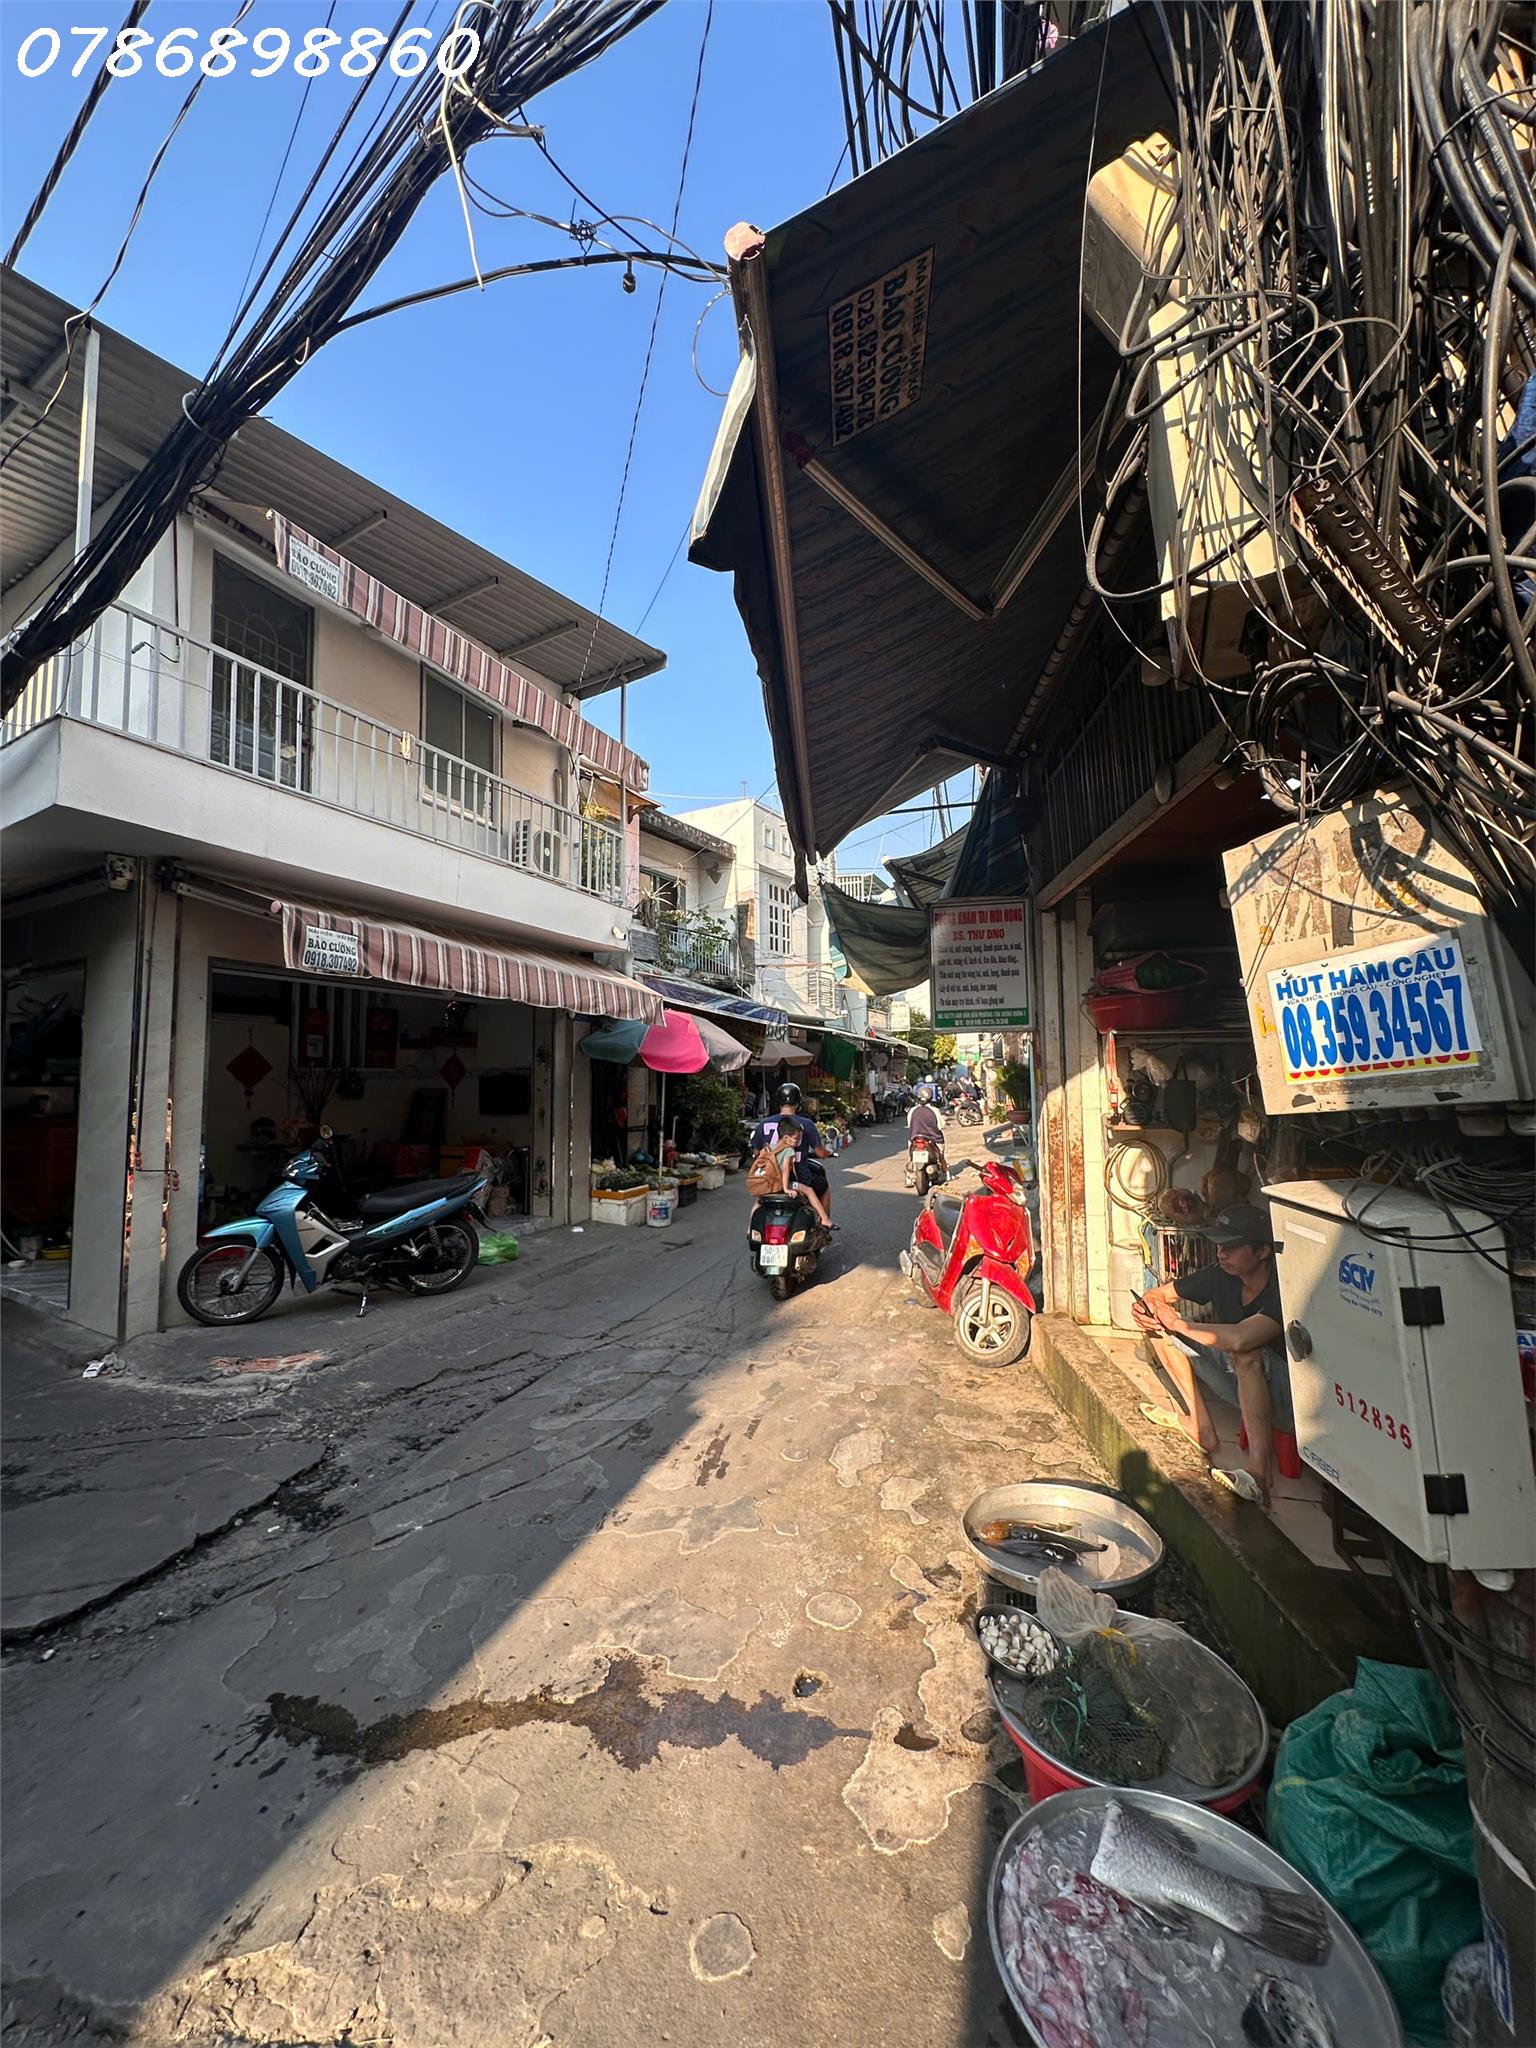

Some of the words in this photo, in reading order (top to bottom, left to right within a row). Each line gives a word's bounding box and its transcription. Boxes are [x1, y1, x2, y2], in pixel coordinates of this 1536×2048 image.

[307, 935, 327, 950] BẢO
[304, 950, 358, 972] 0918.307492
[1282, 975, 1470, 1069] 08.359.34567
